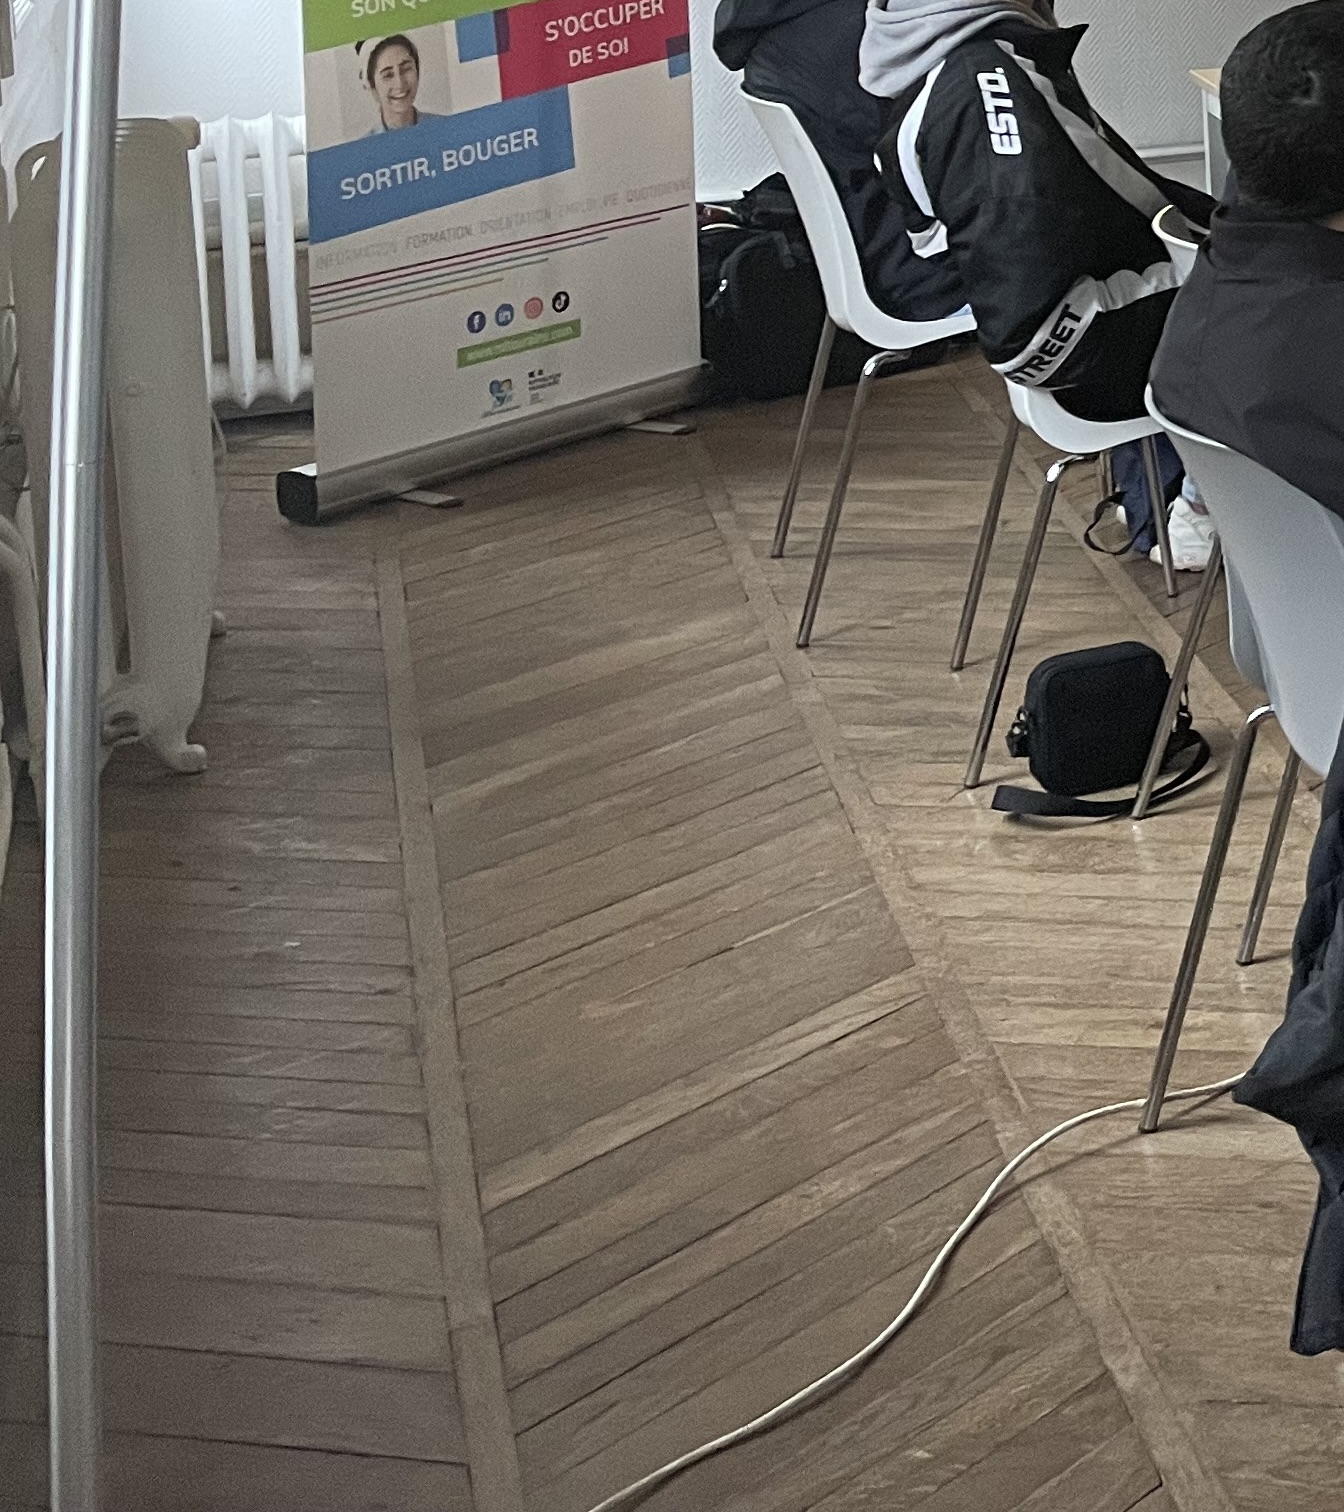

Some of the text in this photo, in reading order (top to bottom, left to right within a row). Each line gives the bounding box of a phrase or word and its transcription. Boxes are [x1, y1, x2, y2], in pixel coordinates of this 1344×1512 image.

[568, 37, 629, 68] DE SOI
[340, 128, 539, 200] SORTIR, BOUGER
